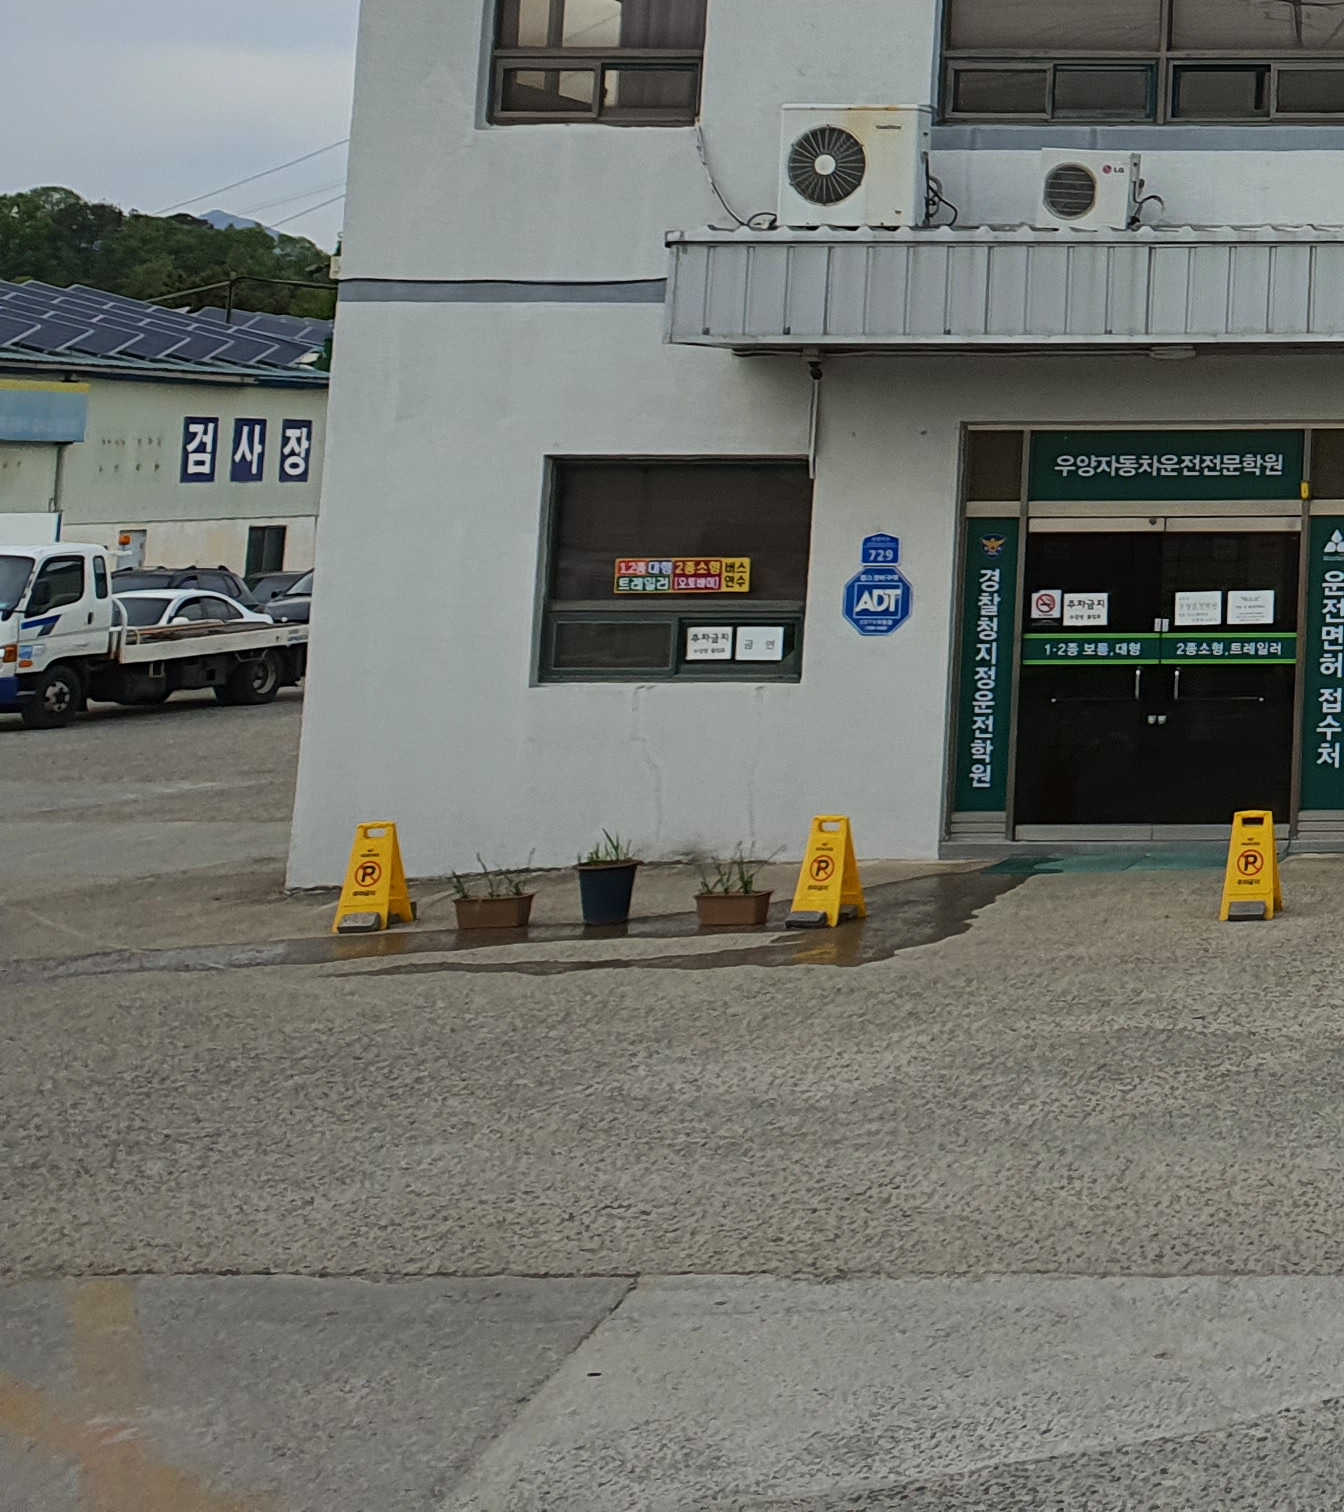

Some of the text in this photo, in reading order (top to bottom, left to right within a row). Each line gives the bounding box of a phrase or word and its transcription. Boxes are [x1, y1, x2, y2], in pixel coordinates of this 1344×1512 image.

[185, 422, 312, 477] 검사장
[1053, 453, 1284, 478] 우양자동차운전전문학원
[868, 549, 894, 562] 729
[855, 588, 902, 613] ADT
[968, 567, 1002, 789] 경찰청지정운전학원
[1315, 687, 1344, 770] 접수처
